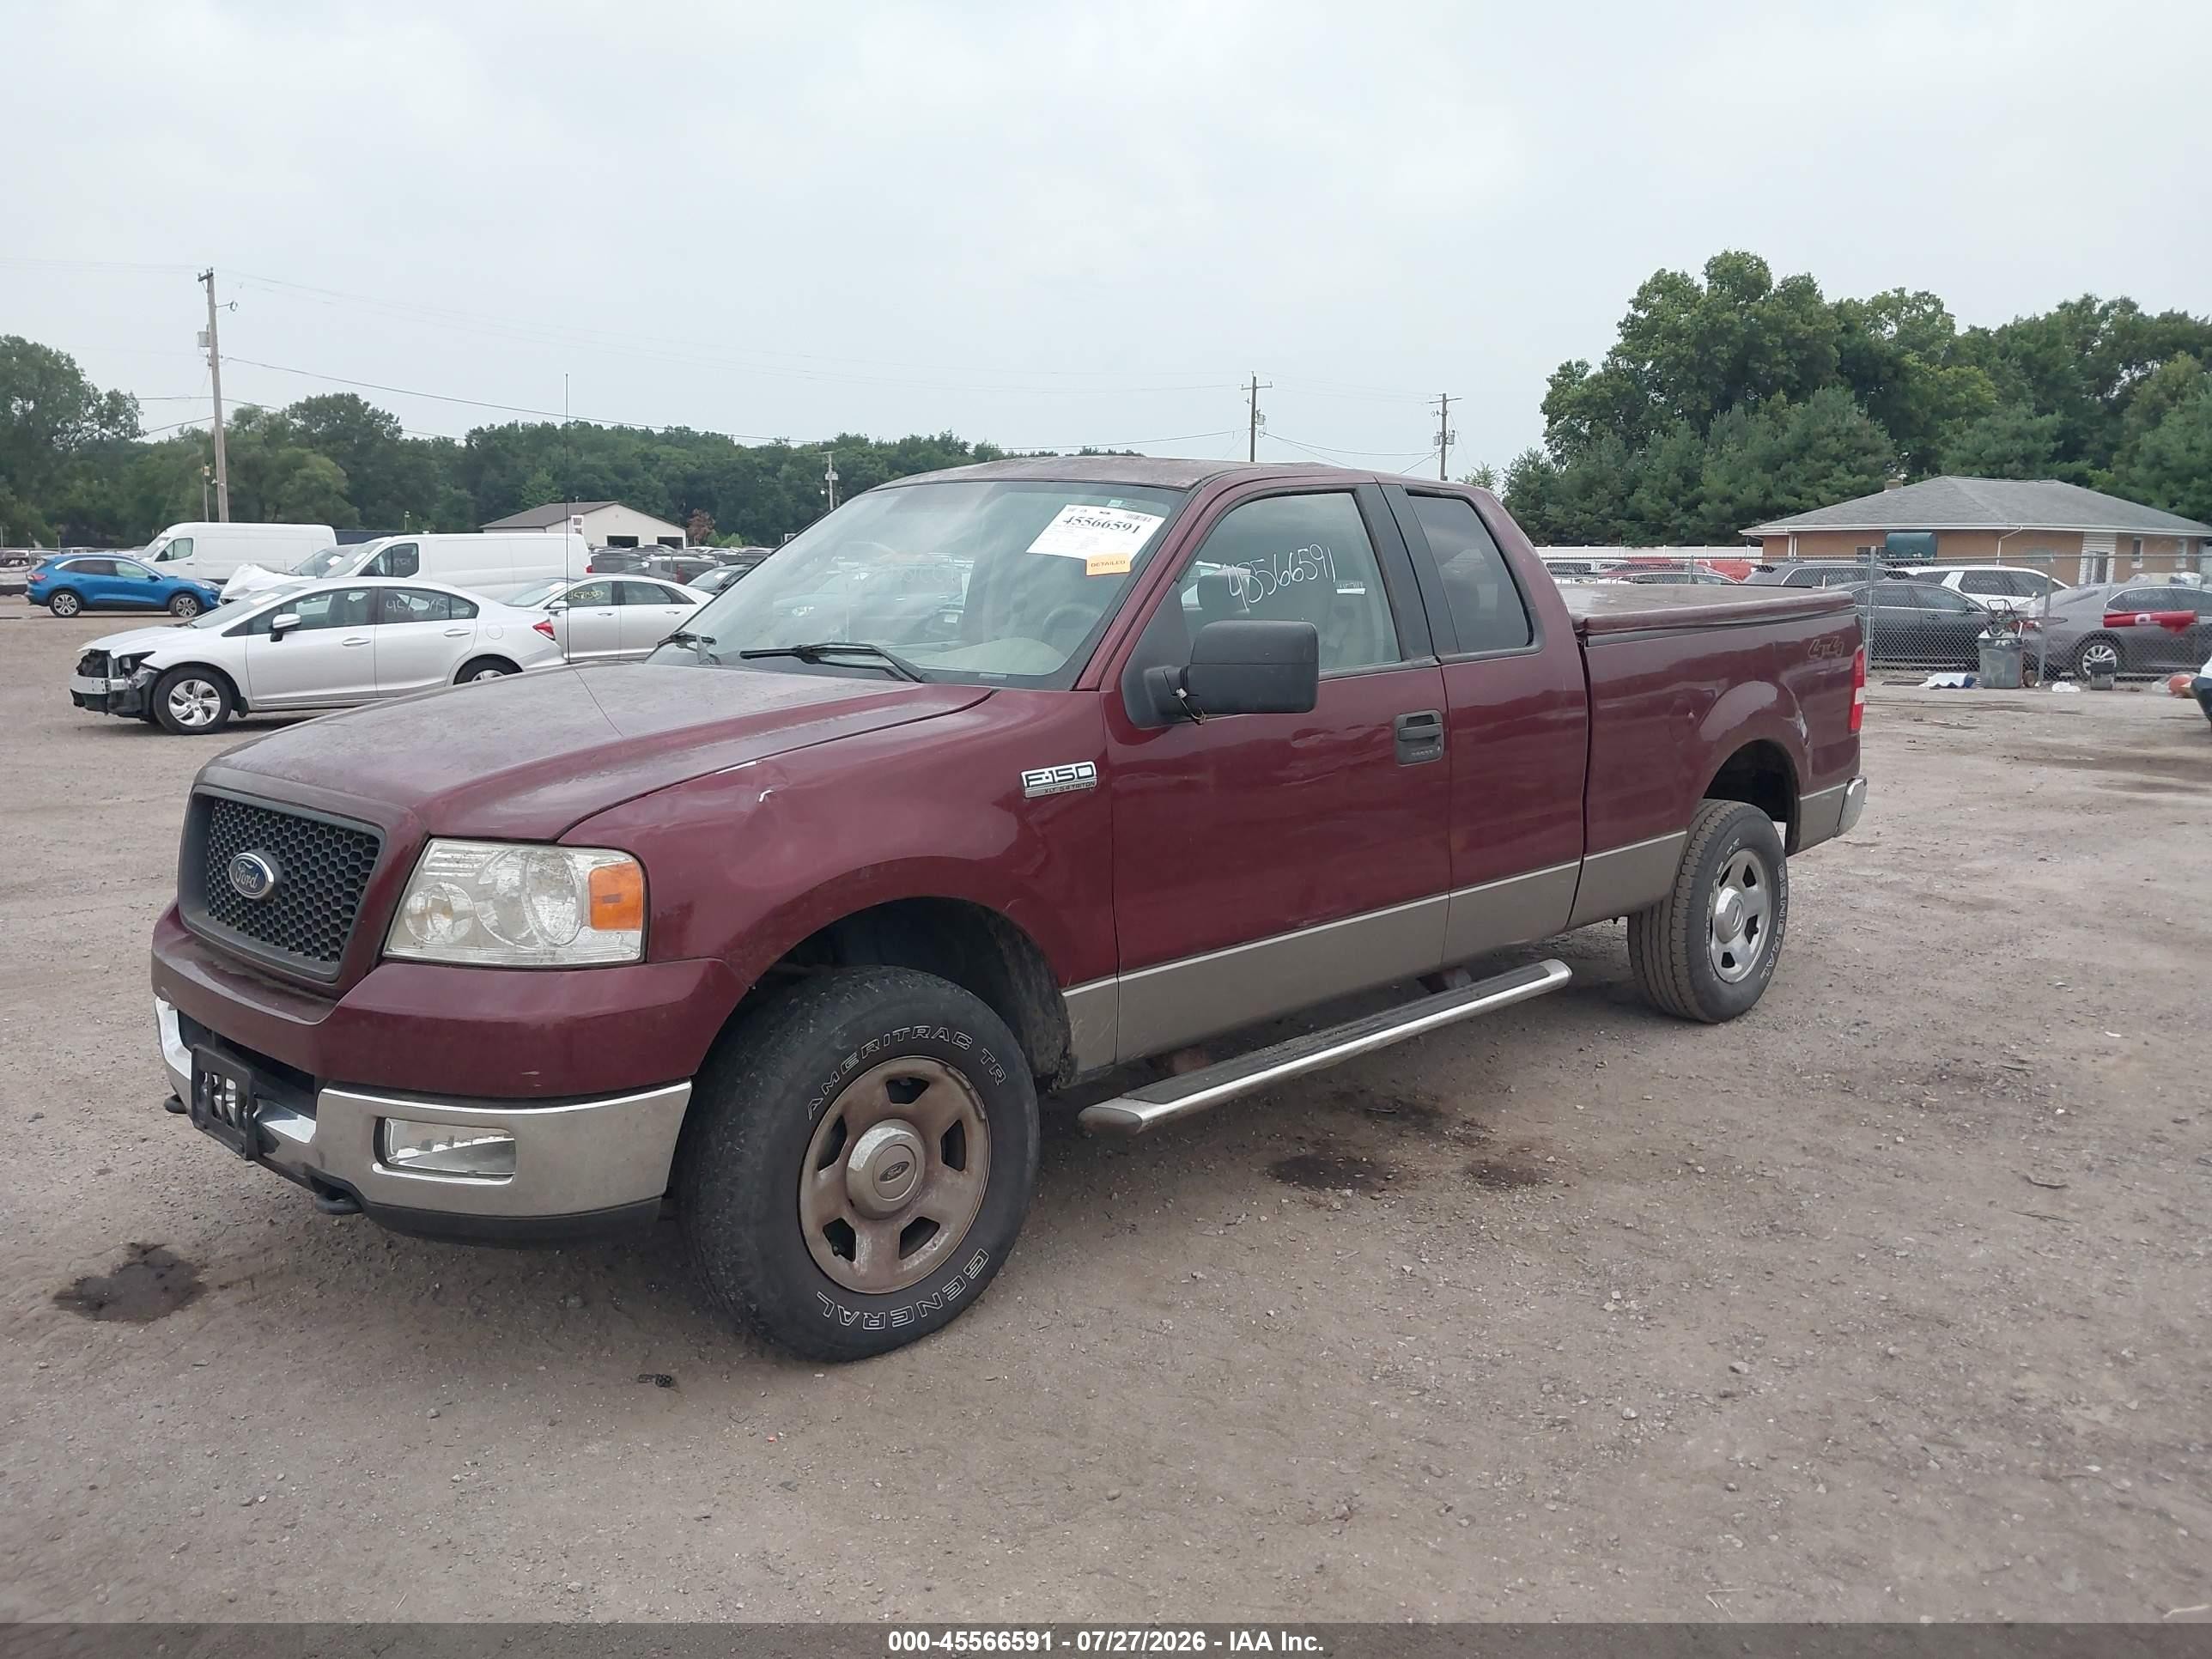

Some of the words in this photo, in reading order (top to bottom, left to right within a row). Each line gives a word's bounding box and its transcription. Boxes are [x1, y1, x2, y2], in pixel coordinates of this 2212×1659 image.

[1063, 516, 1140, 533] 45566591
[1223, 544, 1336, 613] 45566591
[1024, 764, 1095, 787] F-150
[235, 860, 259, 889] Ford
[807, 1025, 973, 1121] AMERITRAC
[980, 1048, 1007, 1085] TR
[817, 1248, 990, 1330] GENERAL
